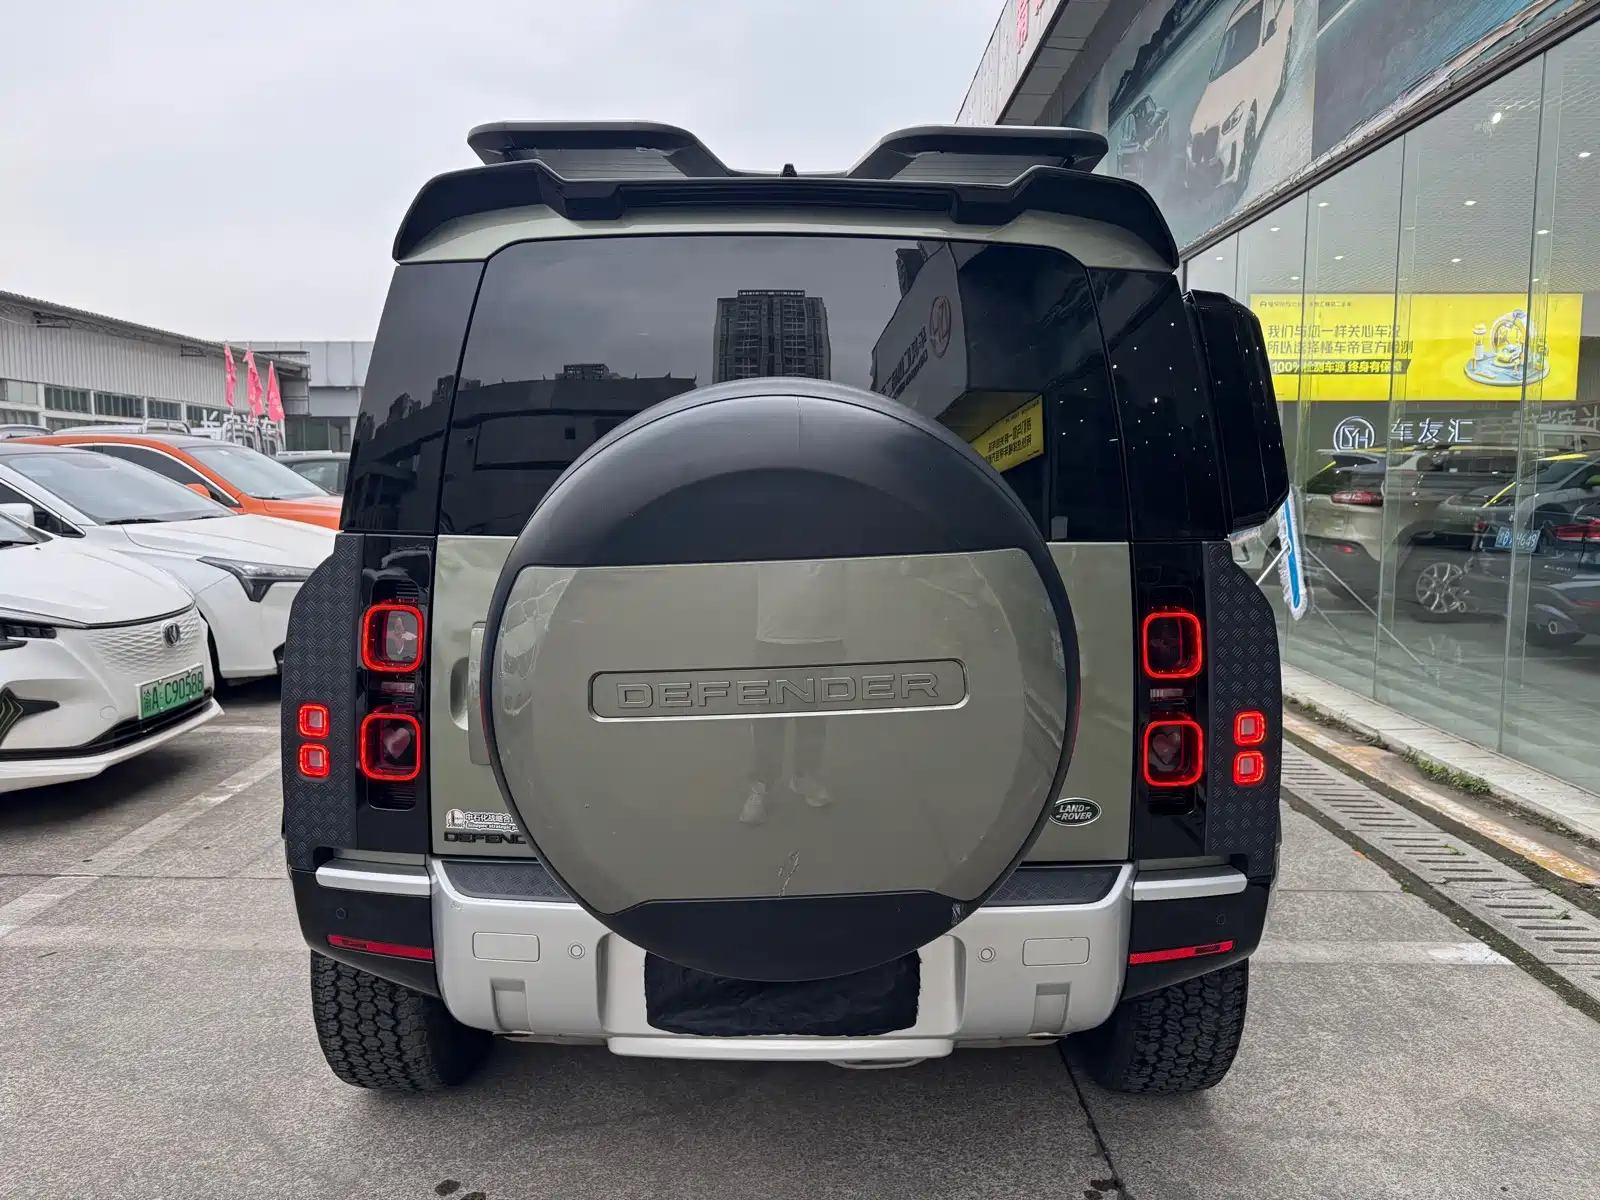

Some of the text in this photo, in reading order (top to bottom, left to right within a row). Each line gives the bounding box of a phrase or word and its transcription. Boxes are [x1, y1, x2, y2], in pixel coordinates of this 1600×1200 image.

[1268, 324, 1401, 339] 我们与您一样关心车况
[1389, 417, 1474, 443] 车友汇
[616, 673, 938, 709] DEFENDER
[1059, 804, 1085, 812] LAND
[1060, 812, 1092, 820] ROVER
